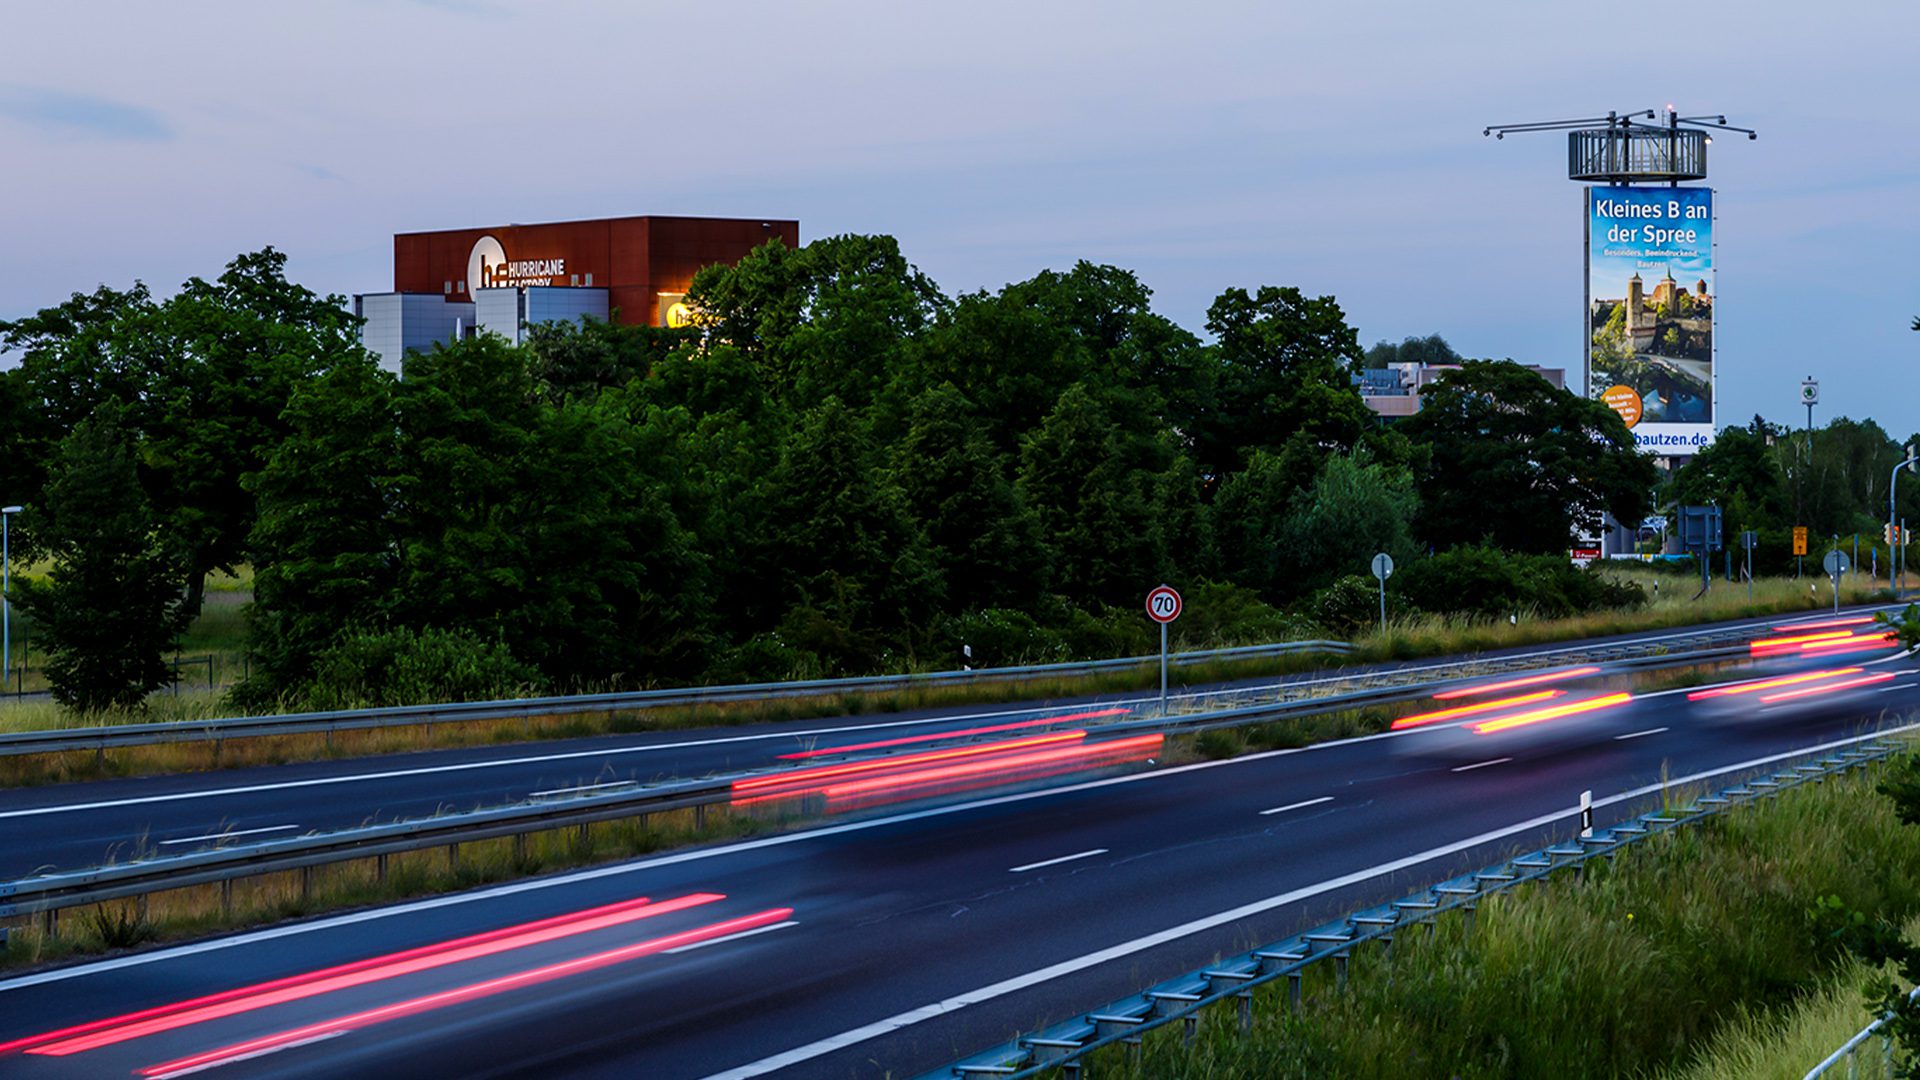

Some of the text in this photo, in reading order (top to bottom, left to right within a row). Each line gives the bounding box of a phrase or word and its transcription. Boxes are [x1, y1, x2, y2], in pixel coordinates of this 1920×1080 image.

[1596, 199, 1707, 219] Kleines B an
[1607, 223, 1697, 247] der Spree
[508, 259, 565, 278] HURRICANE
[1154, 596, 1174, 612] 70
